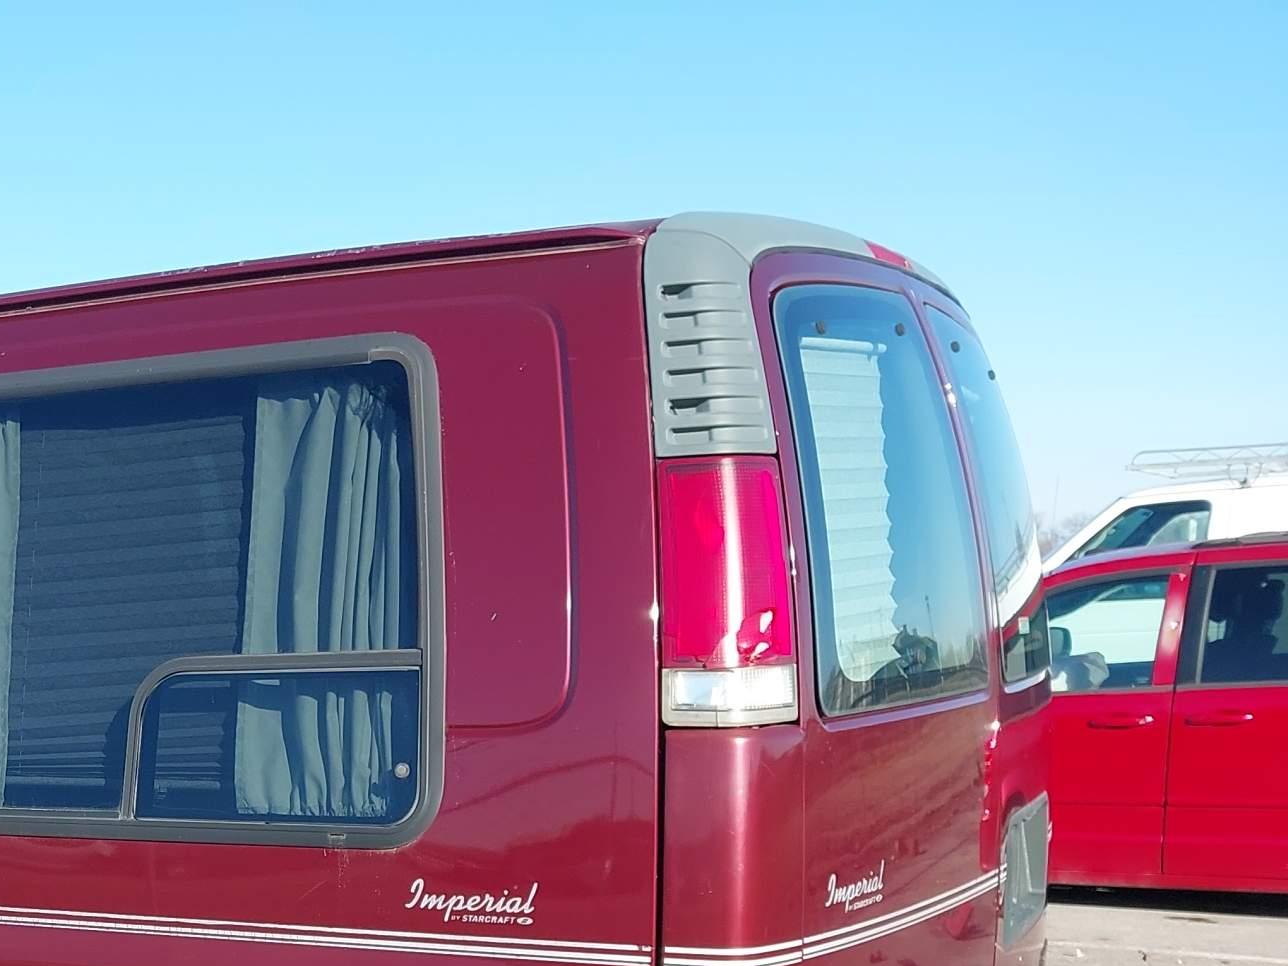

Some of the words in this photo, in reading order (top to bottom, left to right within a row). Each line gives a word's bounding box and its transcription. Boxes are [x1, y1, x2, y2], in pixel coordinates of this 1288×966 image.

[405, 878, 539, 922] Imperial
[825, 859, 885, 914] Imperial
[462, 914, 516, 924] STARCRAFT
